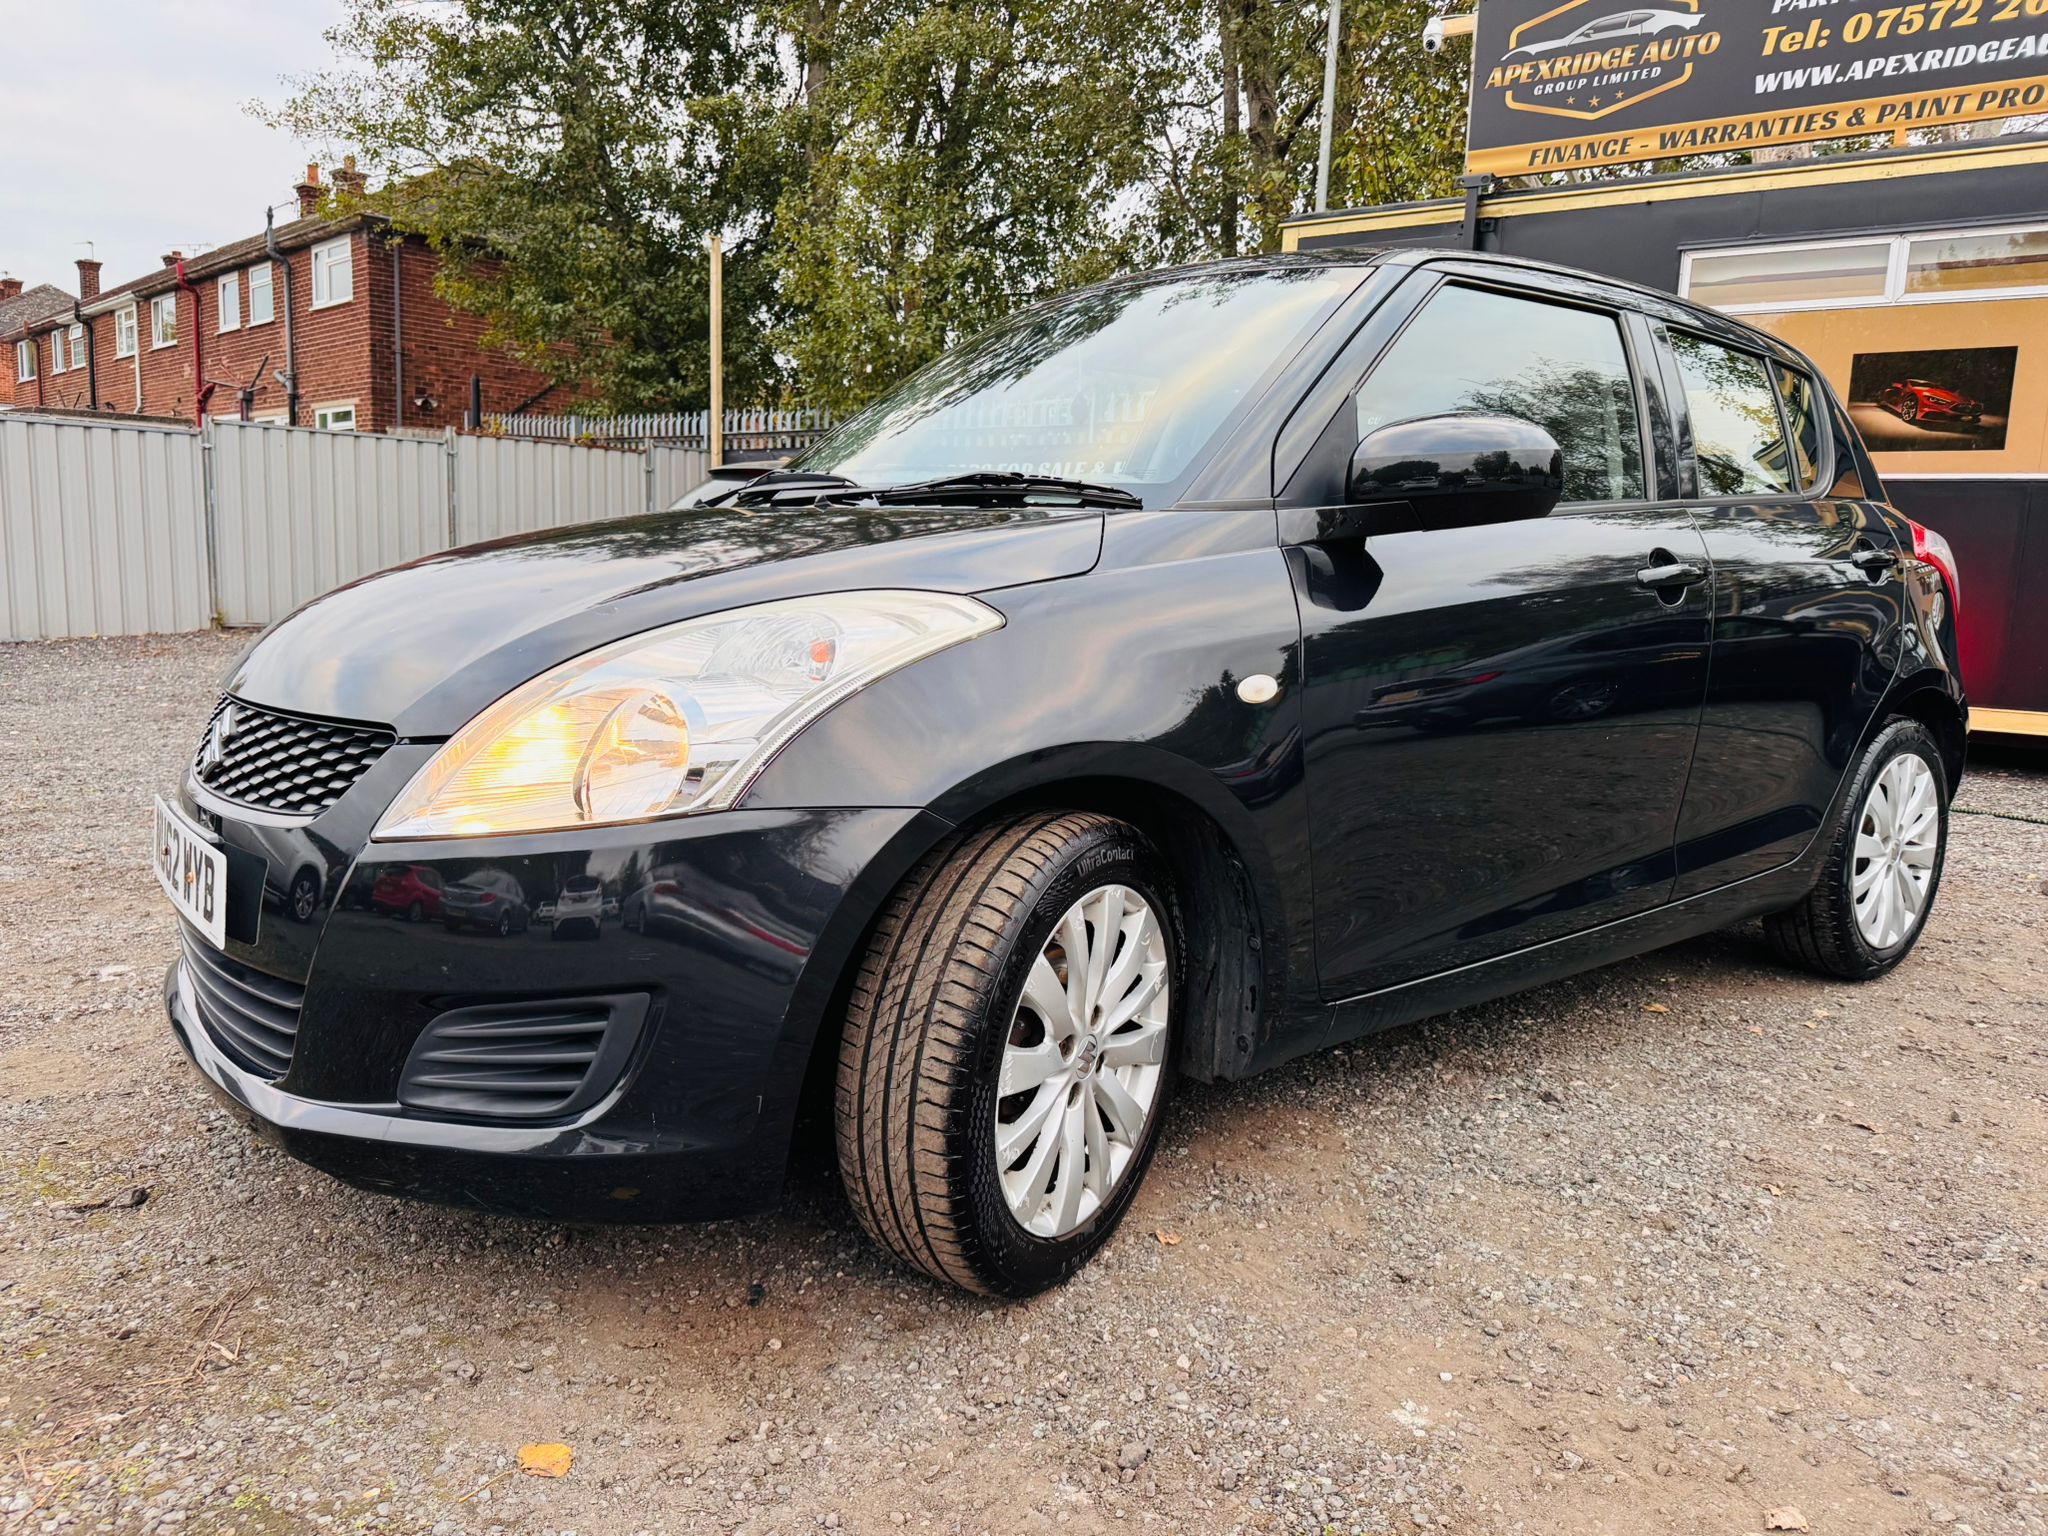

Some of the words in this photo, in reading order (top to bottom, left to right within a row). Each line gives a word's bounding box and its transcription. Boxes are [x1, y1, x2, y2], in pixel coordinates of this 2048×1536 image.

[1762, 19, 1831, 56] Tel:
[1842, 0, 1982, 43] 07572
[1485, 44, 1639, 89] APEXRIDGE
[1639, 31, 1721, 64] AUTO
[1533, 78, 1588, 96] GROUP
[1592, 66, 1662, 87] LIMITED
[1528, 136, 1634, 167] FINANCE
[1659, 110, 1838, 150] WARRANTIES
[1846, 107, 1865, 128] &
[1876, 93, 1972, 124] PAINT
[1076, 845, 1135, 877] UltraContact
